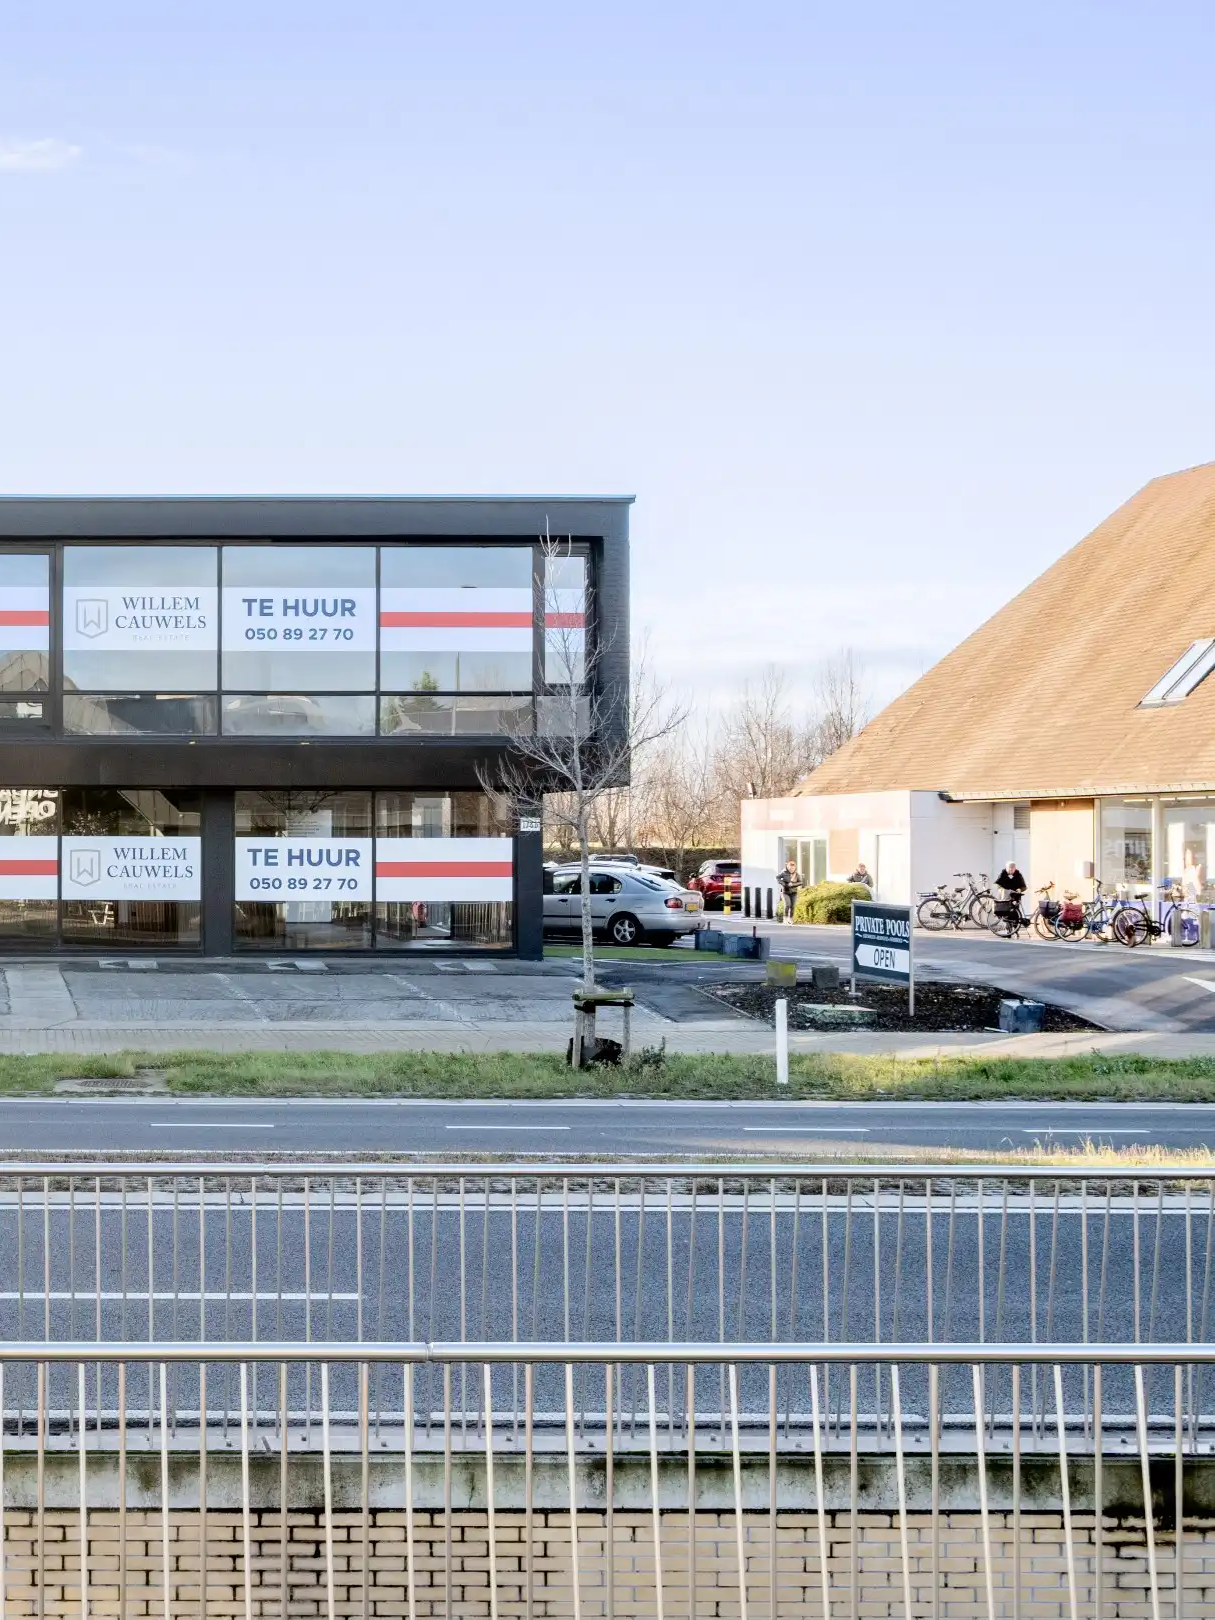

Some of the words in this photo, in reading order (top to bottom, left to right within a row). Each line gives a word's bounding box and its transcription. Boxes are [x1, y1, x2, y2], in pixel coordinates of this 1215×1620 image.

[122, 596, 200, 610] WILLEM
[242, 598, 273, 617] TE
[282, 598, 356, 617] HUUR
[115, 615, 207, 629] CAUWELS
[245, 627, 278, 641] 050
[282, 627, 303, 641] 89
[308, 627, 328, 641] 27
[333, 628, 354, 641] 70
[113, 847, 187, 861] WILLEM
[247, 848, 279, 867] TE
[287, 848, 361, 867] HUUR
[107, 865, 193, 879] CAUWELS
[250, 877, 283, 890] 050
[287, 877, 308, 890] 89
[313, 877, 333, 890] 27
[337, 878, 358, 890] 70
[855, 915, 884, 934] PRIVATE
[886, 919, 910, 938] POOLS
[873, 948, 896, 969] OPEN
